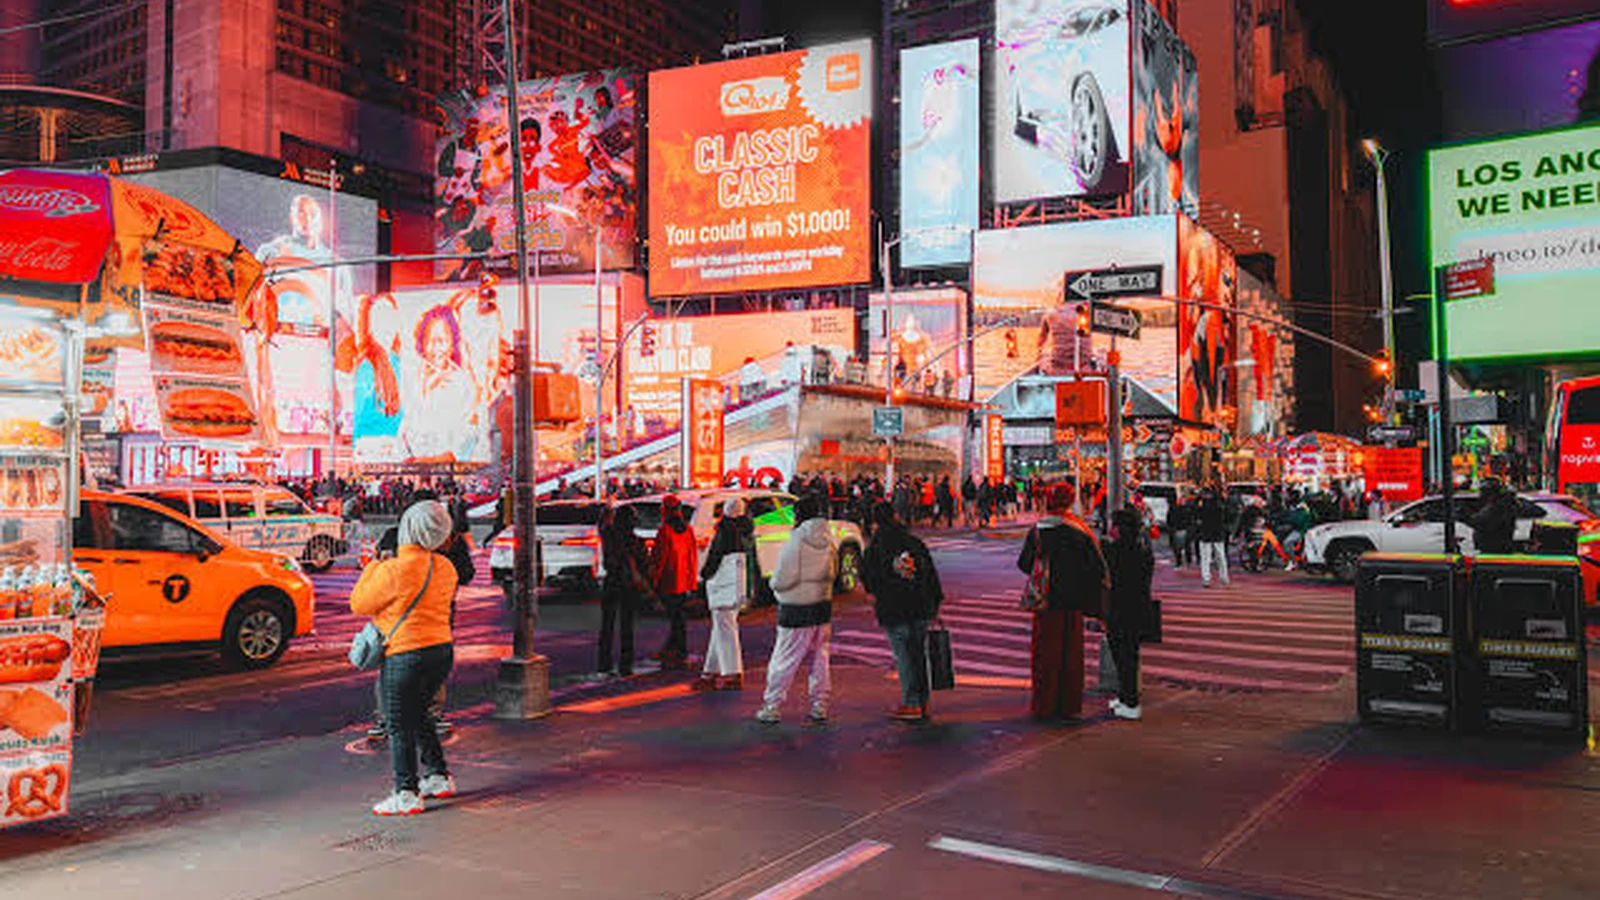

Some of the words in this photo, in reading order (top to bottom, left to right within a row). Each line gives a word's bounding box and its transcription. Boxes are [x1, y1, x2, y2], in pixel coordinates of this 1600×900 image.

[695, 124, 819, 173] CLASSIC
[718, 166, 796, 209] CASH
[1456, 161, 1521, 188] LOS
[1457, 194, 1510, 218] WE
[1522, 181, 1600, 211] NEE
[665, 224, 695, 246] You
[700, 217, 746, 243] could
[751, 215, 782, 238] win
[787, 209, 850, 238] $1,000!
[1078, 278, 1107, 293] ONE
[1118, 273, 1151, 288] WAY
[168, 578, 185, 600] T
